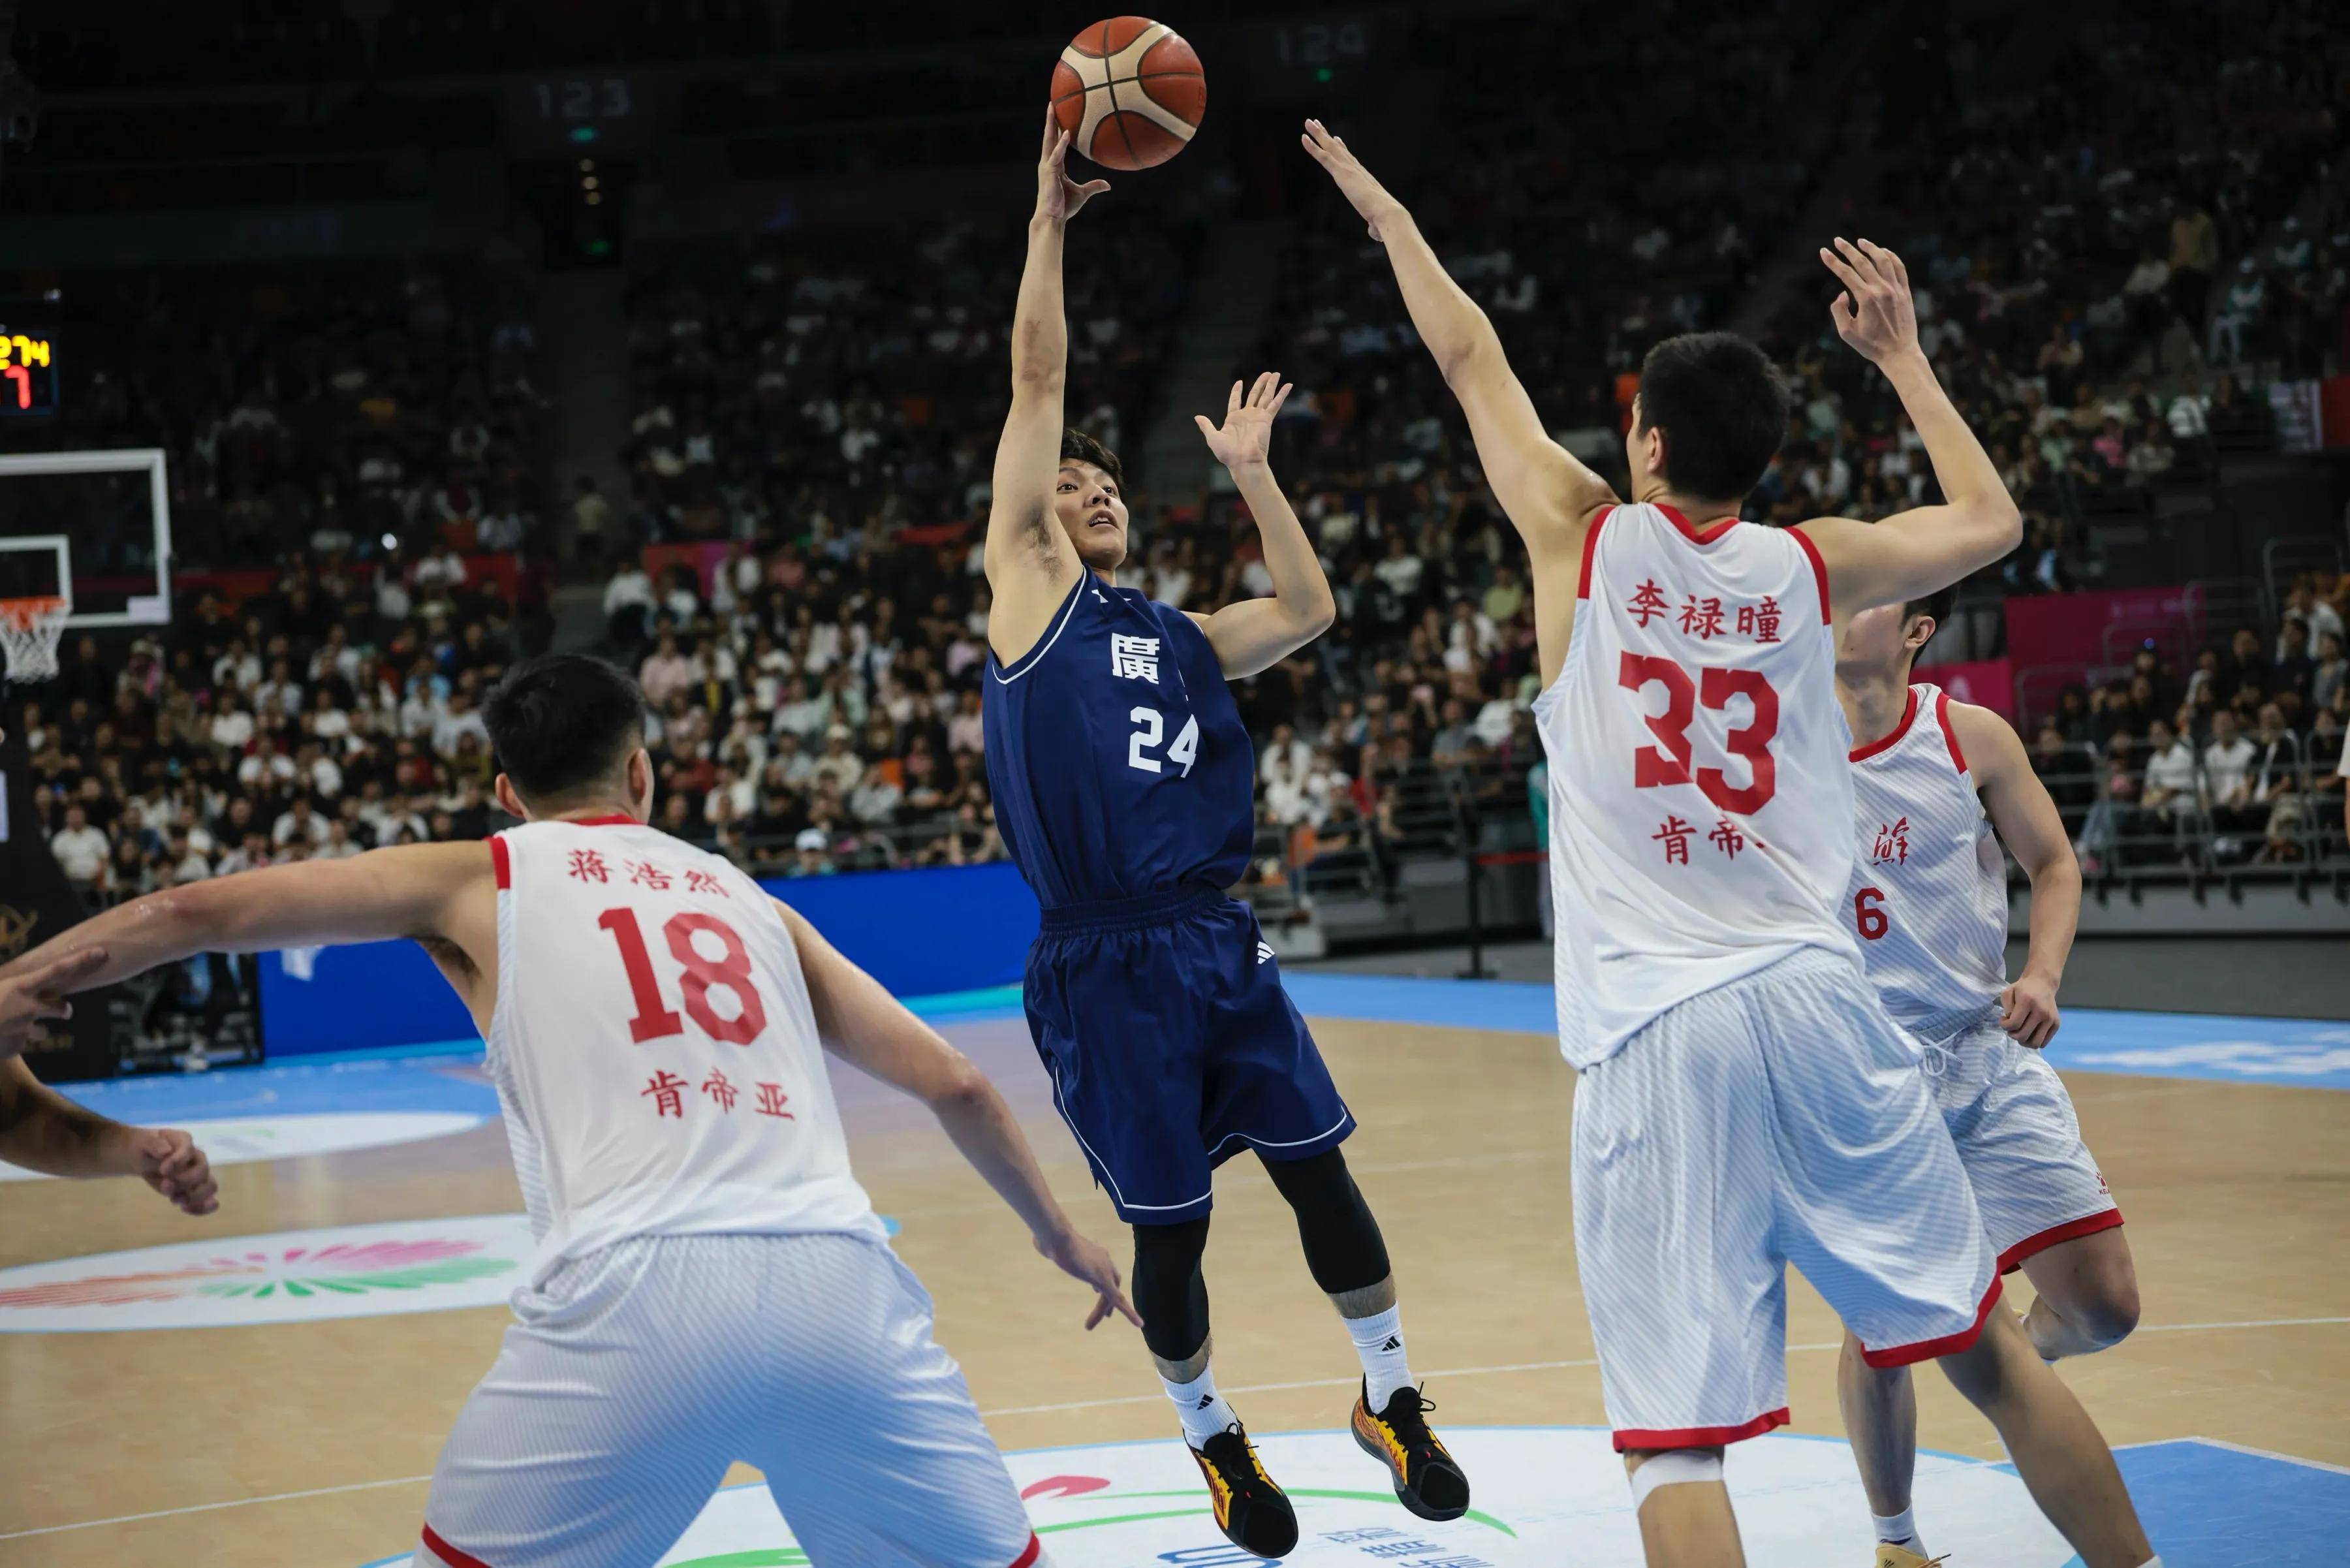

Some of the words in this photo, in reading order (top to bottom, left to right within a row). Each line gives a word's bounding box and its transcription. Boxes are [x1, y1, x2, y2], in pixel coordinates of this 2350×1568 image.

[533, 79, 631, 118] 123
[1627, 578, 1782, 644] 李禄曈
[1111, 633, 1160, 685] 廣
[1129, 706, 1199, 778] 24
[1618, 650, 1779, 816] 33
[1652, 815, 1765, 866] 肯帝
[567, 849, 730, 898] 蒋浩然
[1855, 887, 1888, 941] 6
[597, 906, 767, 1046] 18
[640, 1069, 795, 1120] 肯帝亚
